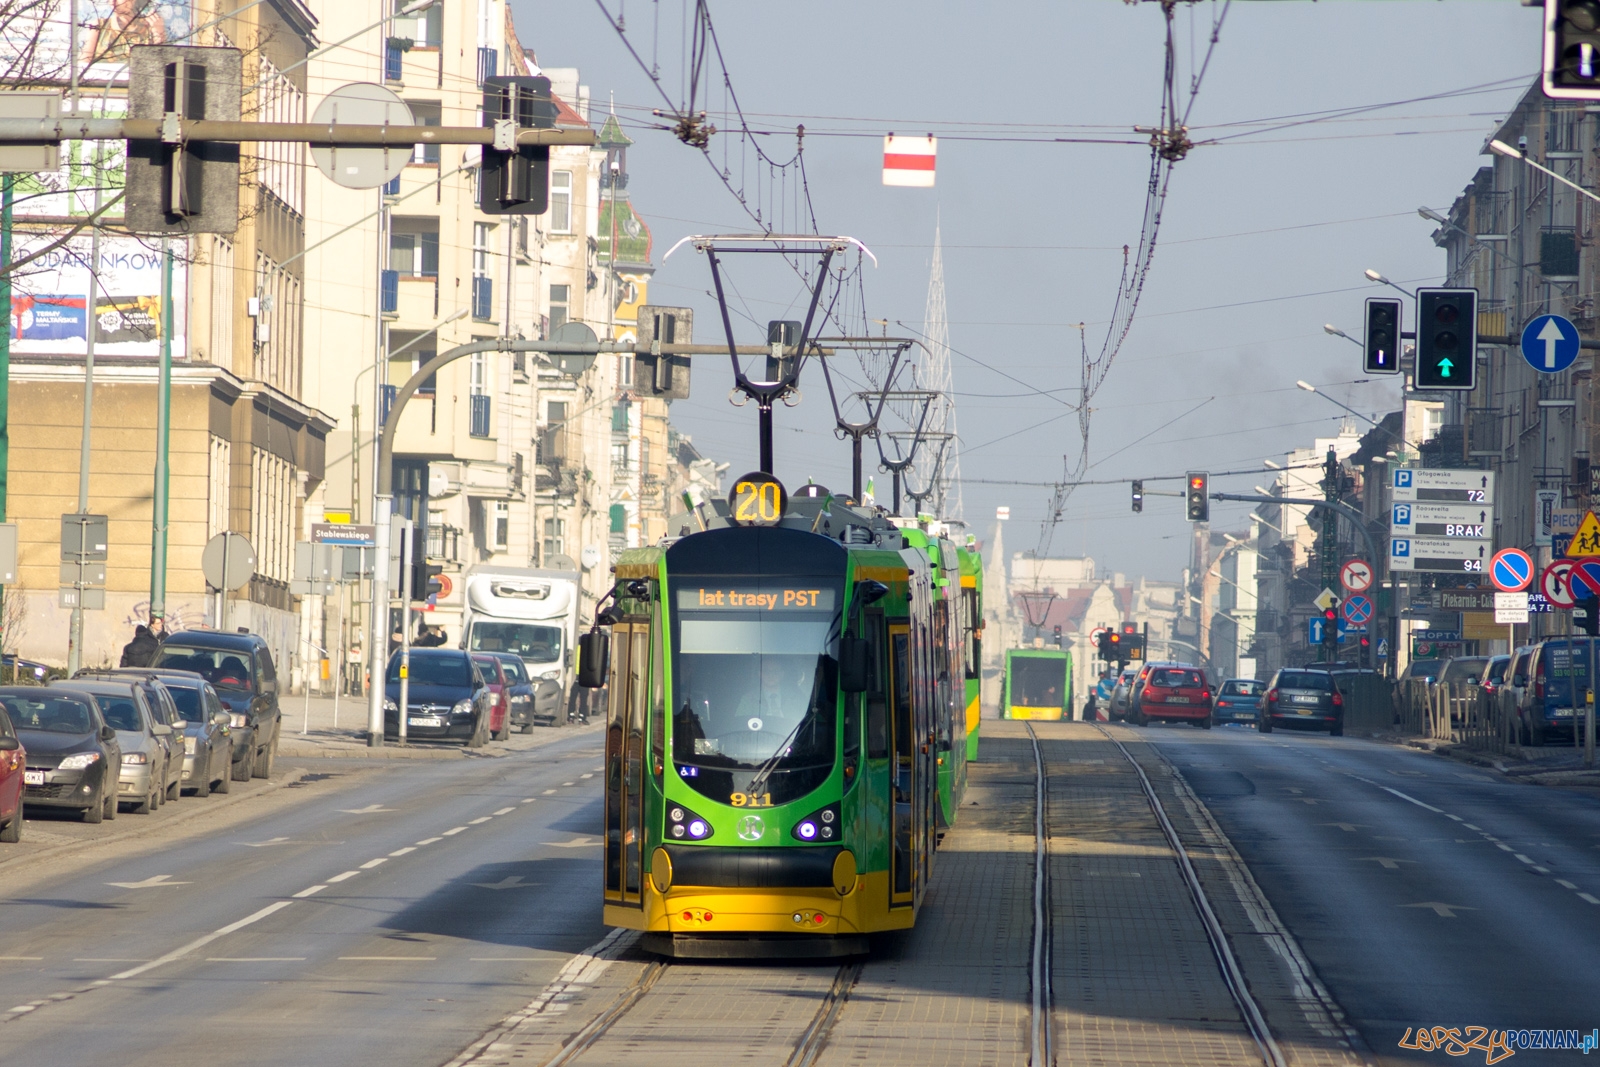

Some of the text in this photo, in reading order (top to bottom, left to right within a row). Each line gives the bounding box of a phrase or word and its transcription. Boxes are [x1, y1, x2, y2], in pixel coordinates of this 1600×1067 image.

[1398, 472, 1409, 486] P
[736, 482, 780, 521] 20
[1468, 490, 1484, 502] 72
[316, 530, 370, 541] Stablewskiego
[1446, 525, 1483, 536] BRAK
[1396, 541, 1406, 555] P
[1464, 560, 1482, 571] 94
[699, 589, 820, 610] lat trasy PST
[730, 792, 774, 806] 911
